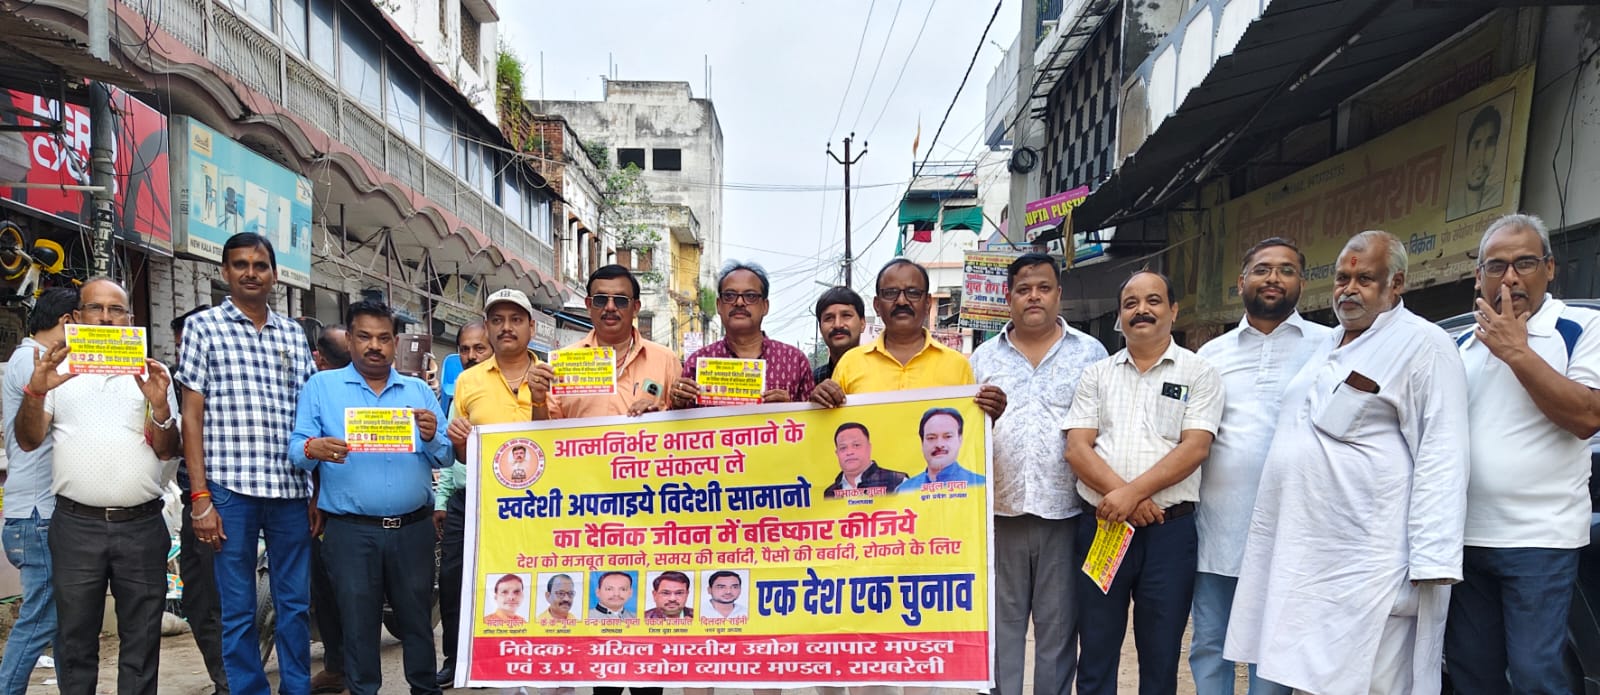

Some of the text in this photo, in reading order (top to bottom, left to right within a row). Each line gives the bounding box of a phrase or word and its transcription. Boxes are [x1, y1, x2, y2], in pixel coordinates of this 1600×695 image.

[1024, 208, 1049, 227] UPTA
[553, 419, 806, 457] आत्मनिर्भर भारत बनाने के
[610, 450, 746, 480] लिए संकल्प ले
[497, 476, 812, 520] स्वदेशी अपनाइये विदेशी सामानो
[945, 480, 968, 492] गुप्ता
[553, 509, 918, 548] का दैनिक जीवन में बहिष्कार कीजिये
[516, 537, 962, 570] देश को मजबूत बनाने, समय की बर्बादी, पैसो की बर्बादी, रोकने के लिए
[756, 567, 976, 627] एक देश एक चुनाव
[587, 639, 654, 656] अखिल
[662, 639, 736, 656] भारतीय
[743, 638, 800, 655] उद्योग
[805, 640, 878, 655] व्यापार
[883, 640, 955, 654] मण्डल
[506, 658, 533, 675] एवं
[589, 662, 626, 679] युवा
[633, 658, 689, 675] उद्योग
[695, 662, 761, 675] व्यापार
[848, 656, 945, 675] रायबरेली
